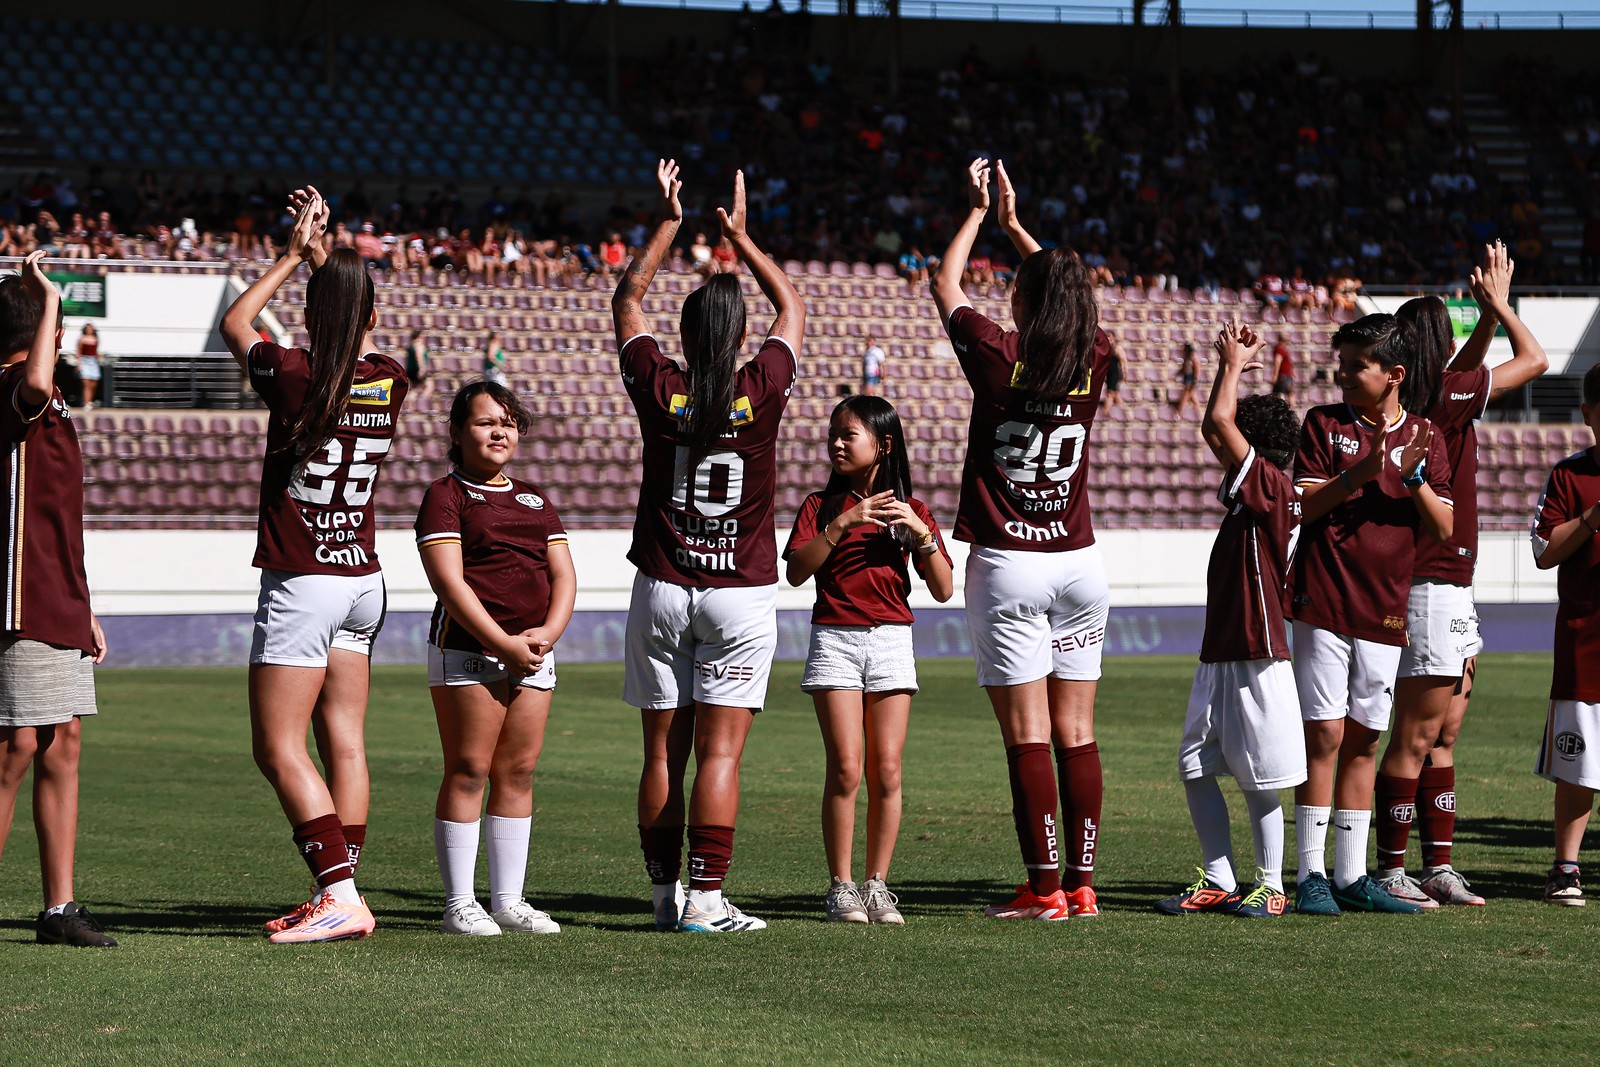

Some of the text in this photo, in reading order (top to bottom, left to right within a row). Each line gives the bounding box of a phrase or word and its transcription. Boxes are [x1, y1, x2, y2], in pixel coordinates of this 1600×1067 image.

[353, 412, 392, 427] DUTRA
[1025, 401, 1072, 418] CAMILA
[993, 420, 1087, 483] 20
[1328, 432, 1360, 450] LUPO
[288, 437, 392, 506] 25
[672, 445, 745, 517] 10
[1023, 498, 1069, 512] SPORT
[299, 508, 364, 530] LUPO
[667, 512, 738, 536] LUPO
[685, 534, 738, 549] SPORT
[1004, 520, 1069, 542] amil
[675, 547, 736, 571] amil
[1557, 734, 1583, 754] AFE
[1044, 813, 1059, 862] LUPO
[1082, 818, 1097, 865] LUPO
